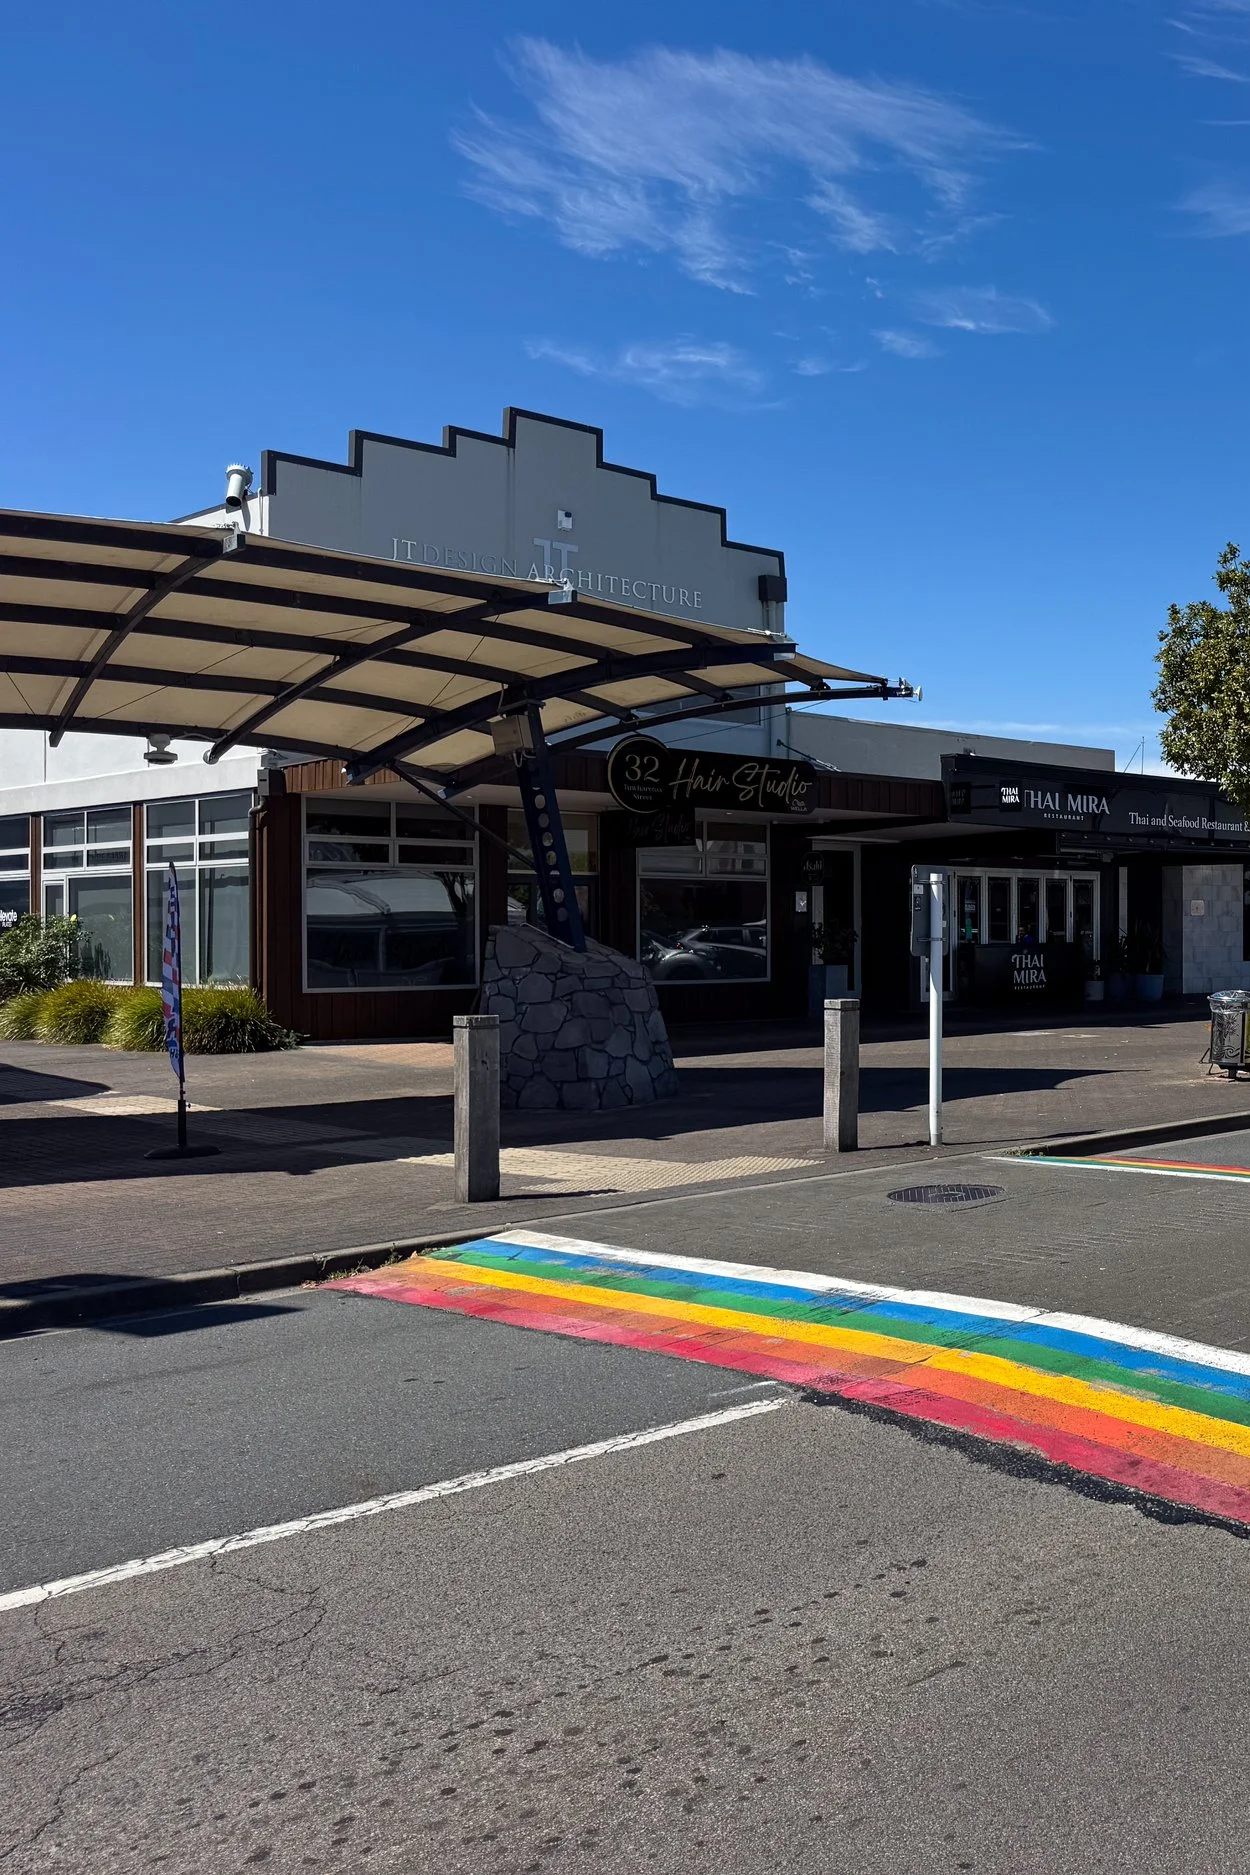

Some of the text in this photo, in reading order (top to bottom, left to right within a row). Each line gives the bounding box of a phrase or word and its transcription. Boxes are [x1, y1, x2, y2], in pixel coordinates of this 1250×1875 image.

[391, 537, 703, 609] JT DESIGN ARCHITECTURE
[624, 754, 660, 783] 32
[668, 757, 813, 808] Hair Studio
[1000, 787, 1019, 796] THAI
[1001, 795, 1020, 804] MIRA
[1024, 789, 1111, 815] THAI MIRA
[1043, 812, 1084, 821] RESTAURANT
[1128, 811, 1150, 826] Thai
[1150, 813, 1167, 827] and
[1168, 814, 1200, 829] Seafood
[1201, 817, 1243, 832] Restaurant
[0, 909, 18, 922] levate
[1011, 953, 1044, 968] THAI
[1013, 969, 1047, 985] MIRA
